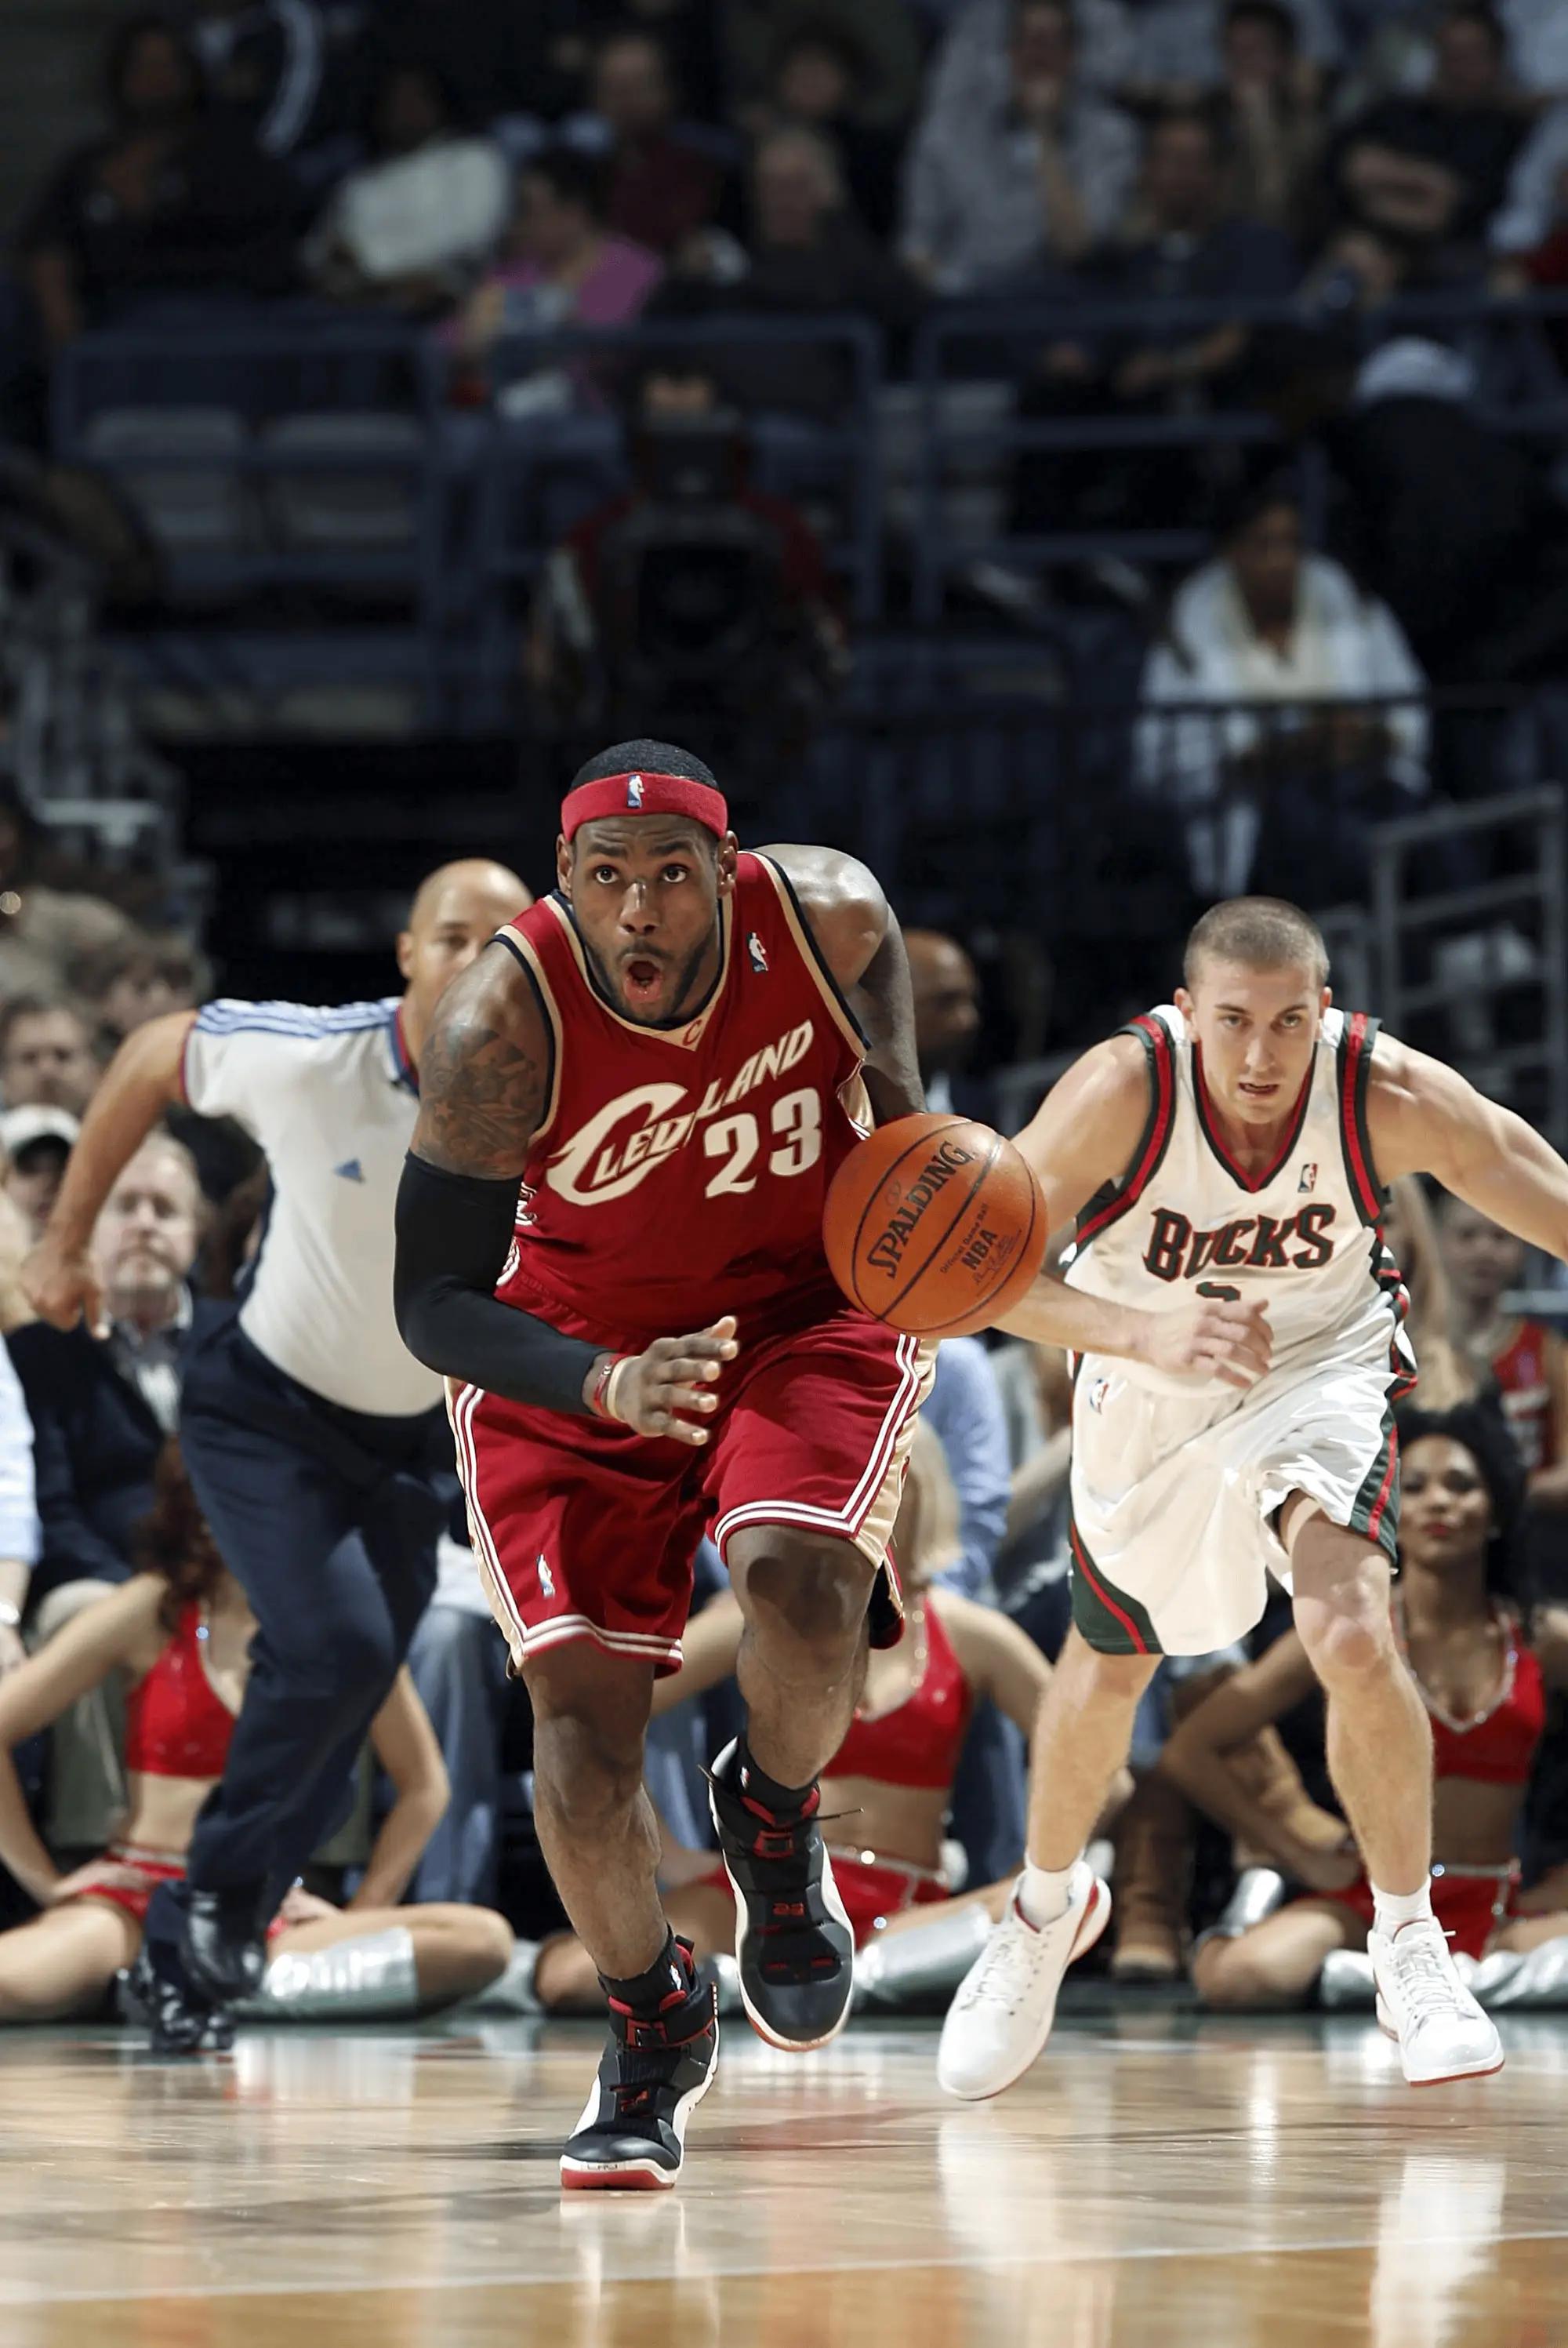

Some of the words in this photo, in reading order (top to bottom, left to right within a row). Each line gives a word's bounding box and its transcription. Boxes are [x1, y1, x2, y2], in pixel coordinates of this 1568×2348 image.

[703, 1087, 822, 1199] 23
[867, 1141, 975, 1279] SPALDING
[961, 1229, 999, 1270] NBA
[1142, 1203, 1337, 1283] BUCKS
